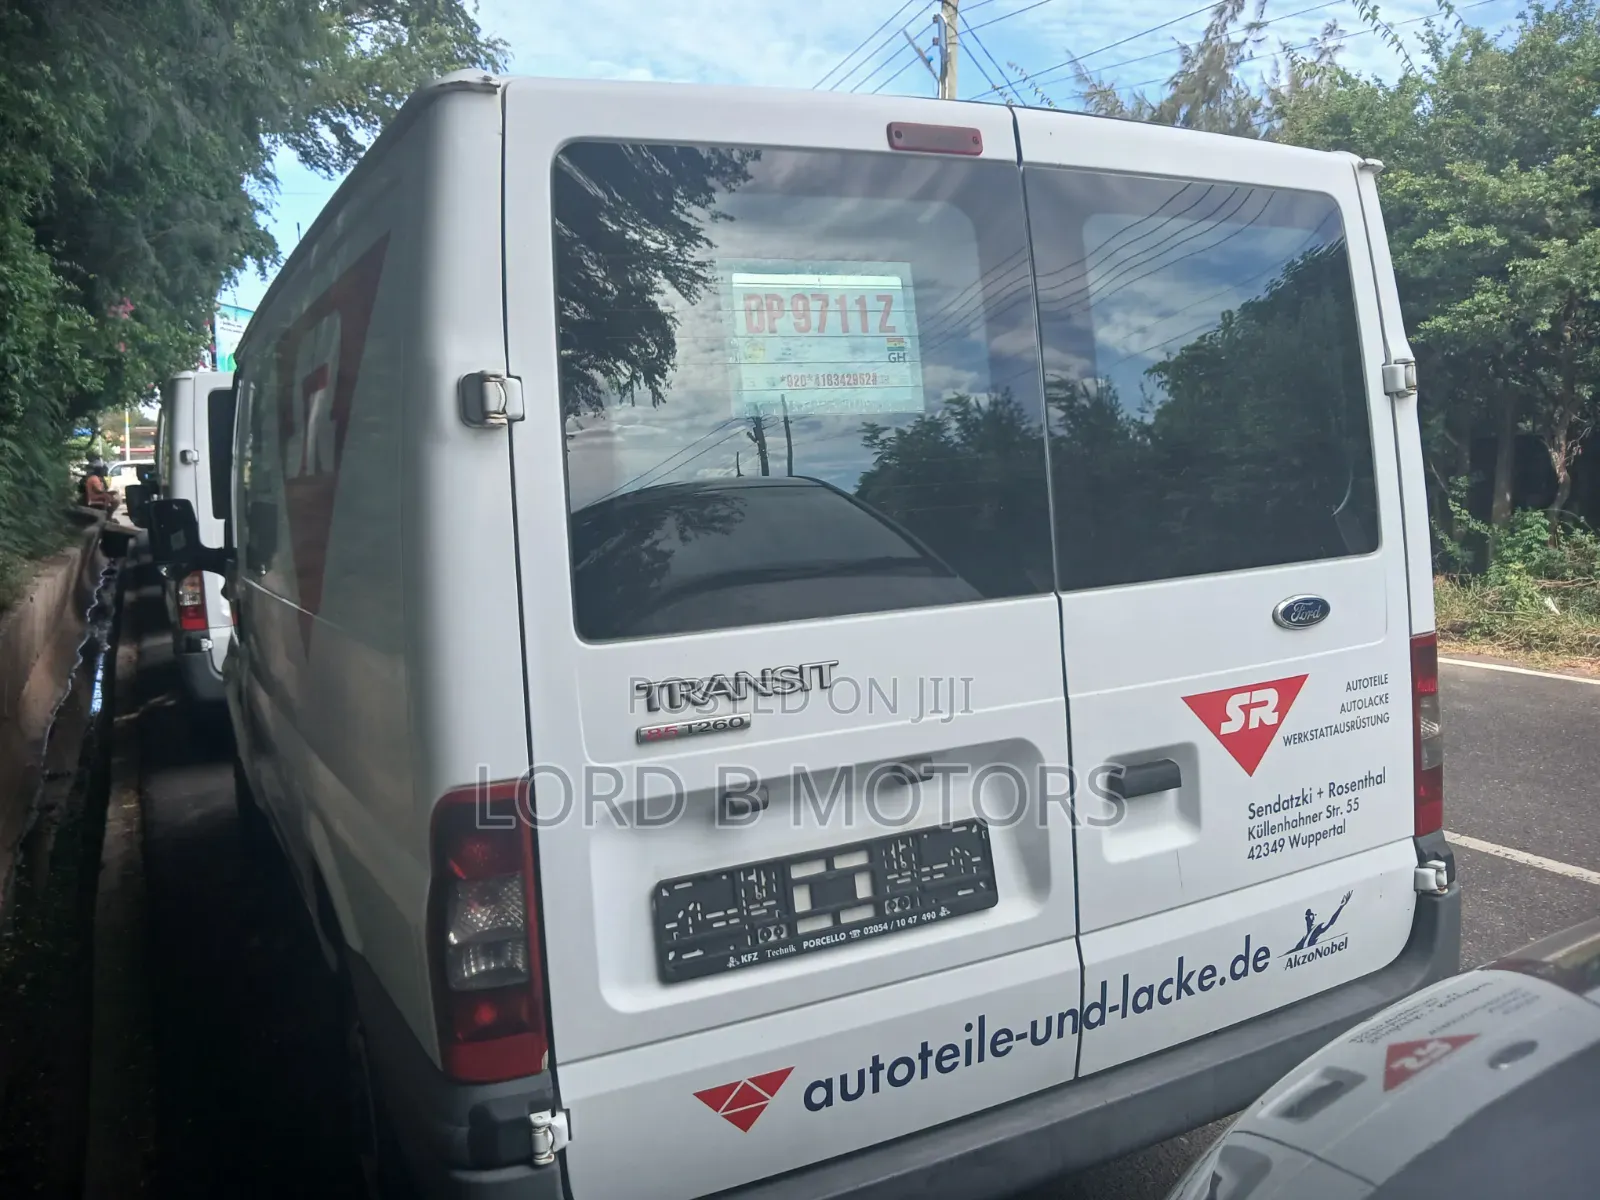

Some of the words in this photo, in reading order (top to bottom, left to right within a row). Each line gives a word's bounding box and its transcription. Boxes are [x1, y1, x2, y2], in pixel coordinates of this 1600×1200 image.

[887, 352, 906, 364] GH
[1290, 601, 1322, 622] Ford
[635, 659, 839, 713] TRANSIT
[1345, 673, 1389, 693] AUTOTEILE
[1219, 687, 1279, 736] SR
[1339, 692, 1390, 715] AUTOLACKE
[682, 716, 745, 735] T260
[1282, 711, 1390, 747] WERKSTATTAUSRÜSTUNG
[1247, 787, 1313, 820] Sendatzki
[1328, 765, 1386, 798] Rosenthal
[1247, 810, 1323, 841] Küllenhahner
[1326, 805, 1343, 819] Str.
[1346, 796, 1360, 813] 55
[1247, 836, 1285, 861] 42349
[1288, 818, 1346, 849] Wuppertal
[741, 953, 759, 964] KFZ
[766, 944, 797, 958] Technik
[802, 932, 847, 950] PORCELLO
[863, 922, 889, 936] 02054
[896, 918, 907, 928] 10
[907, 915, 918, 925] 47
[921, 911, 937, 921] 490
[1283, 936, 1348, 971] AkzoNobel
[803, 933, 1271, 1113] autoteile-und-lacke.de
